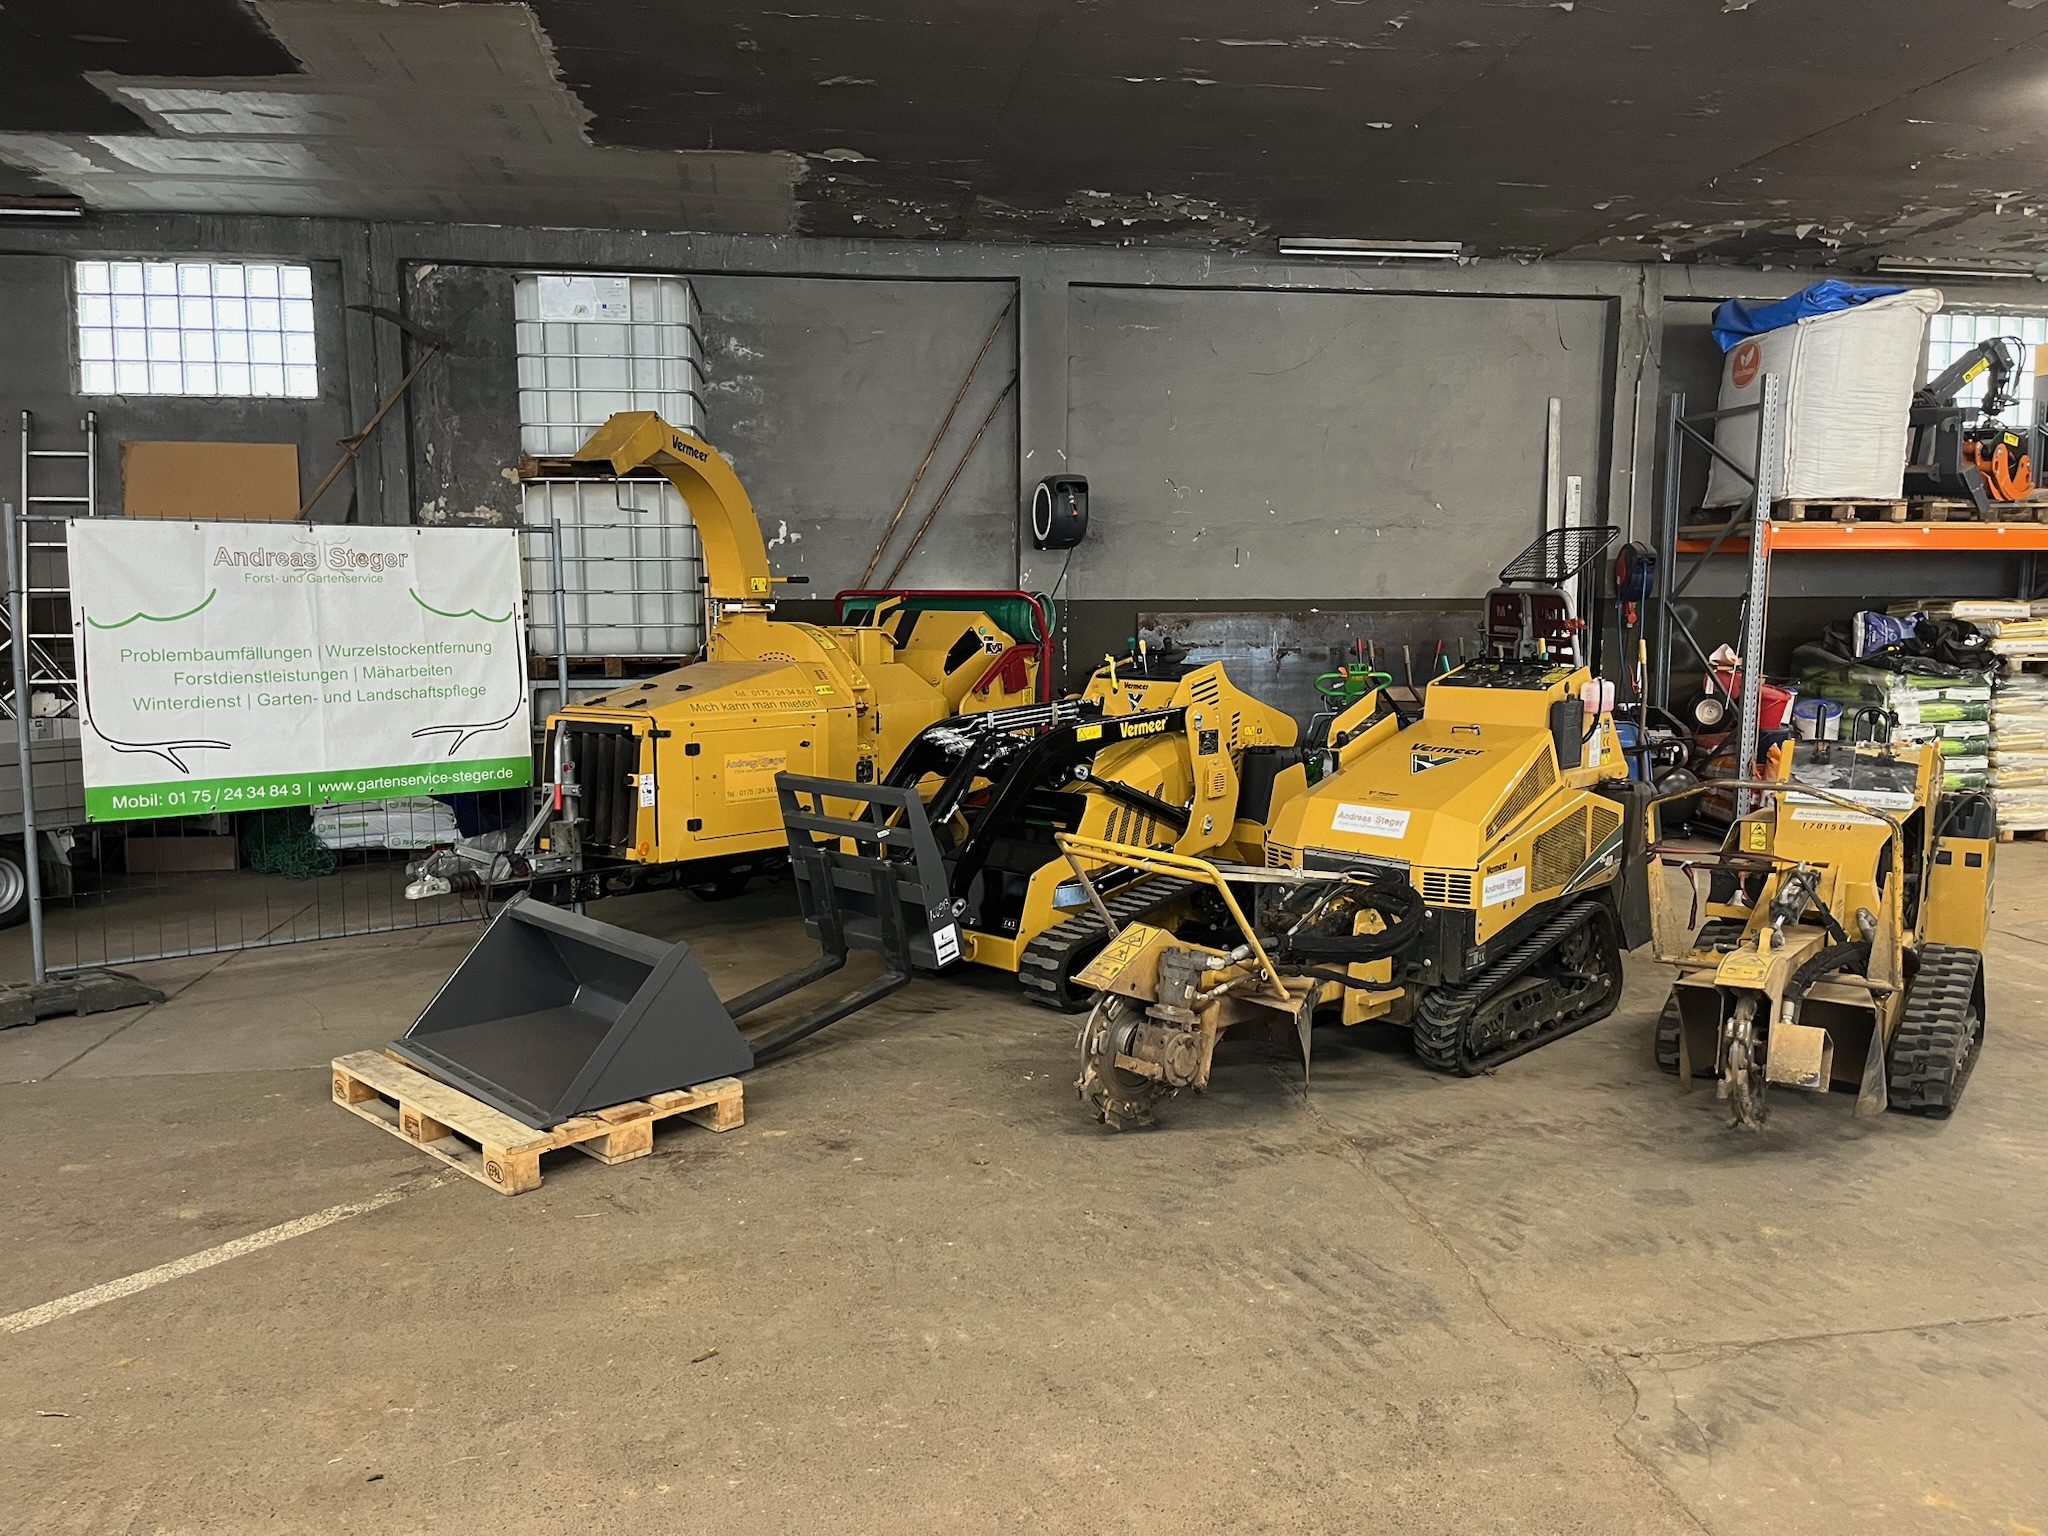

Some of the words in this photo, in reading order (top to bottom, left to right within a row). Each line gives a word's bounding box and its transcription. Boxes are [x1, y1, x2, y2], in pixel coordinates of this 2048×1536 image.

[672, 434, 708, 463] Vermeer
[213, 547, 317, 567] Andreas
[329, 547, 408, 572] Steger
[244, 573, 279, 584] Forst-
[283, 572, 303, 584] und
[307, 573, 383, 584] Gartenservice
[120, 646, 312, 663] Problembaumfällungen
[325, 641, 492, 658] Wurzelstockentfernung
[174, 669, 348, 686] Forstdienstleistungen
[363, 665, 453, 680] Mäharbeiten
[1124, 681, 1149, 690] Vermeer
[133, 695, 241, 711] Winterdienst
[257, 692, 318, 706] Garten-
[323, 690, 351, 703] und
[357, 684, 487, 702] Landschaftspflege
[689, 702, 719, 713] Mich
[720, 702, 750, 711] kann
[752, 701, 778, 709] man
[779, 698, 817, 708] mieten!
[1120, 718, 1167, 738] Vermeer
[1411, 743, 1485, 756] Vermeer
[112, 795, 163, 810] Mobil:
[168, 791, 186, 806] 01
[191, 789, 211, 803] 75
[224, 787, 243, 801] 24
[246, 786, 265, 800] 34
[269, 784, 288, 798] 84
[291, 783, 301, 796] 3
[317, 767, 514, 793] www.gartenservice-steger.de
